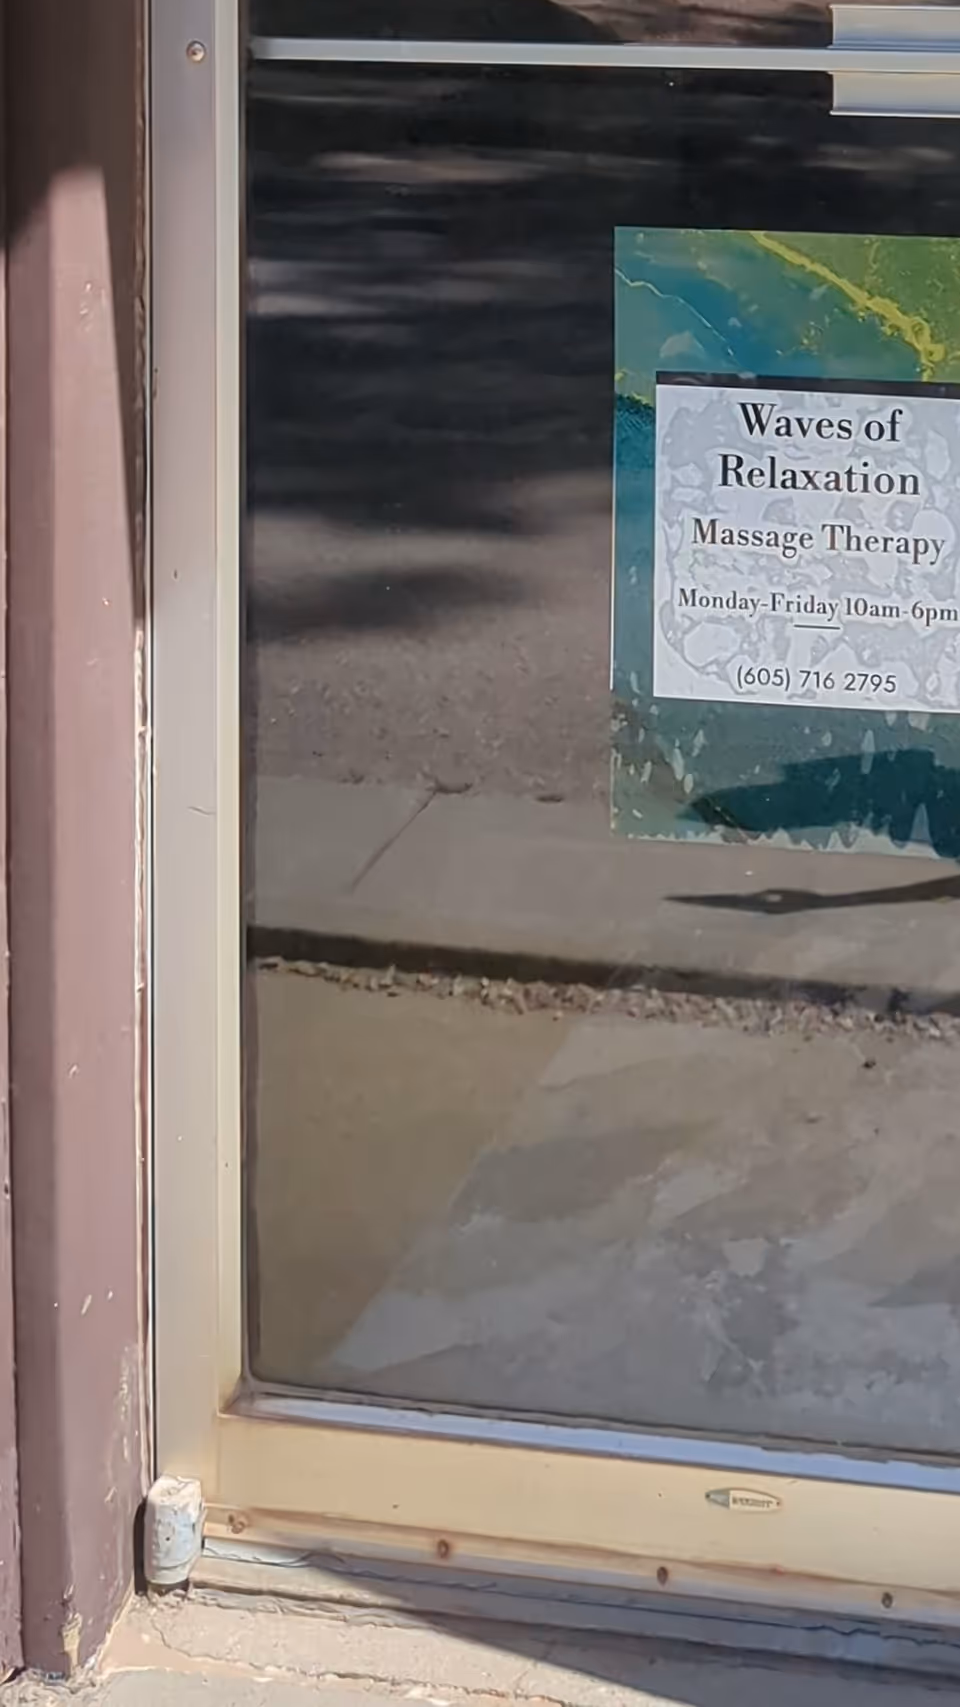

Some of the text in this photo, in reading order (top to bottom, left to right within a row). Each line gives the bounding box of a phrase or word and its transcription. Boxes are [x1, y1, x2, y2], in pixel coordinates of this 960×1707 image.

[738, 402, 903, 443] Waves of
[718, 453, 921, 496] Relaxation
[691, 517, 945, 565] Massage Therapy
[678, 587, 959, 627] Monday-Friday 10am-6pm
[737, 664, 897, 693] (605) 716 2795
